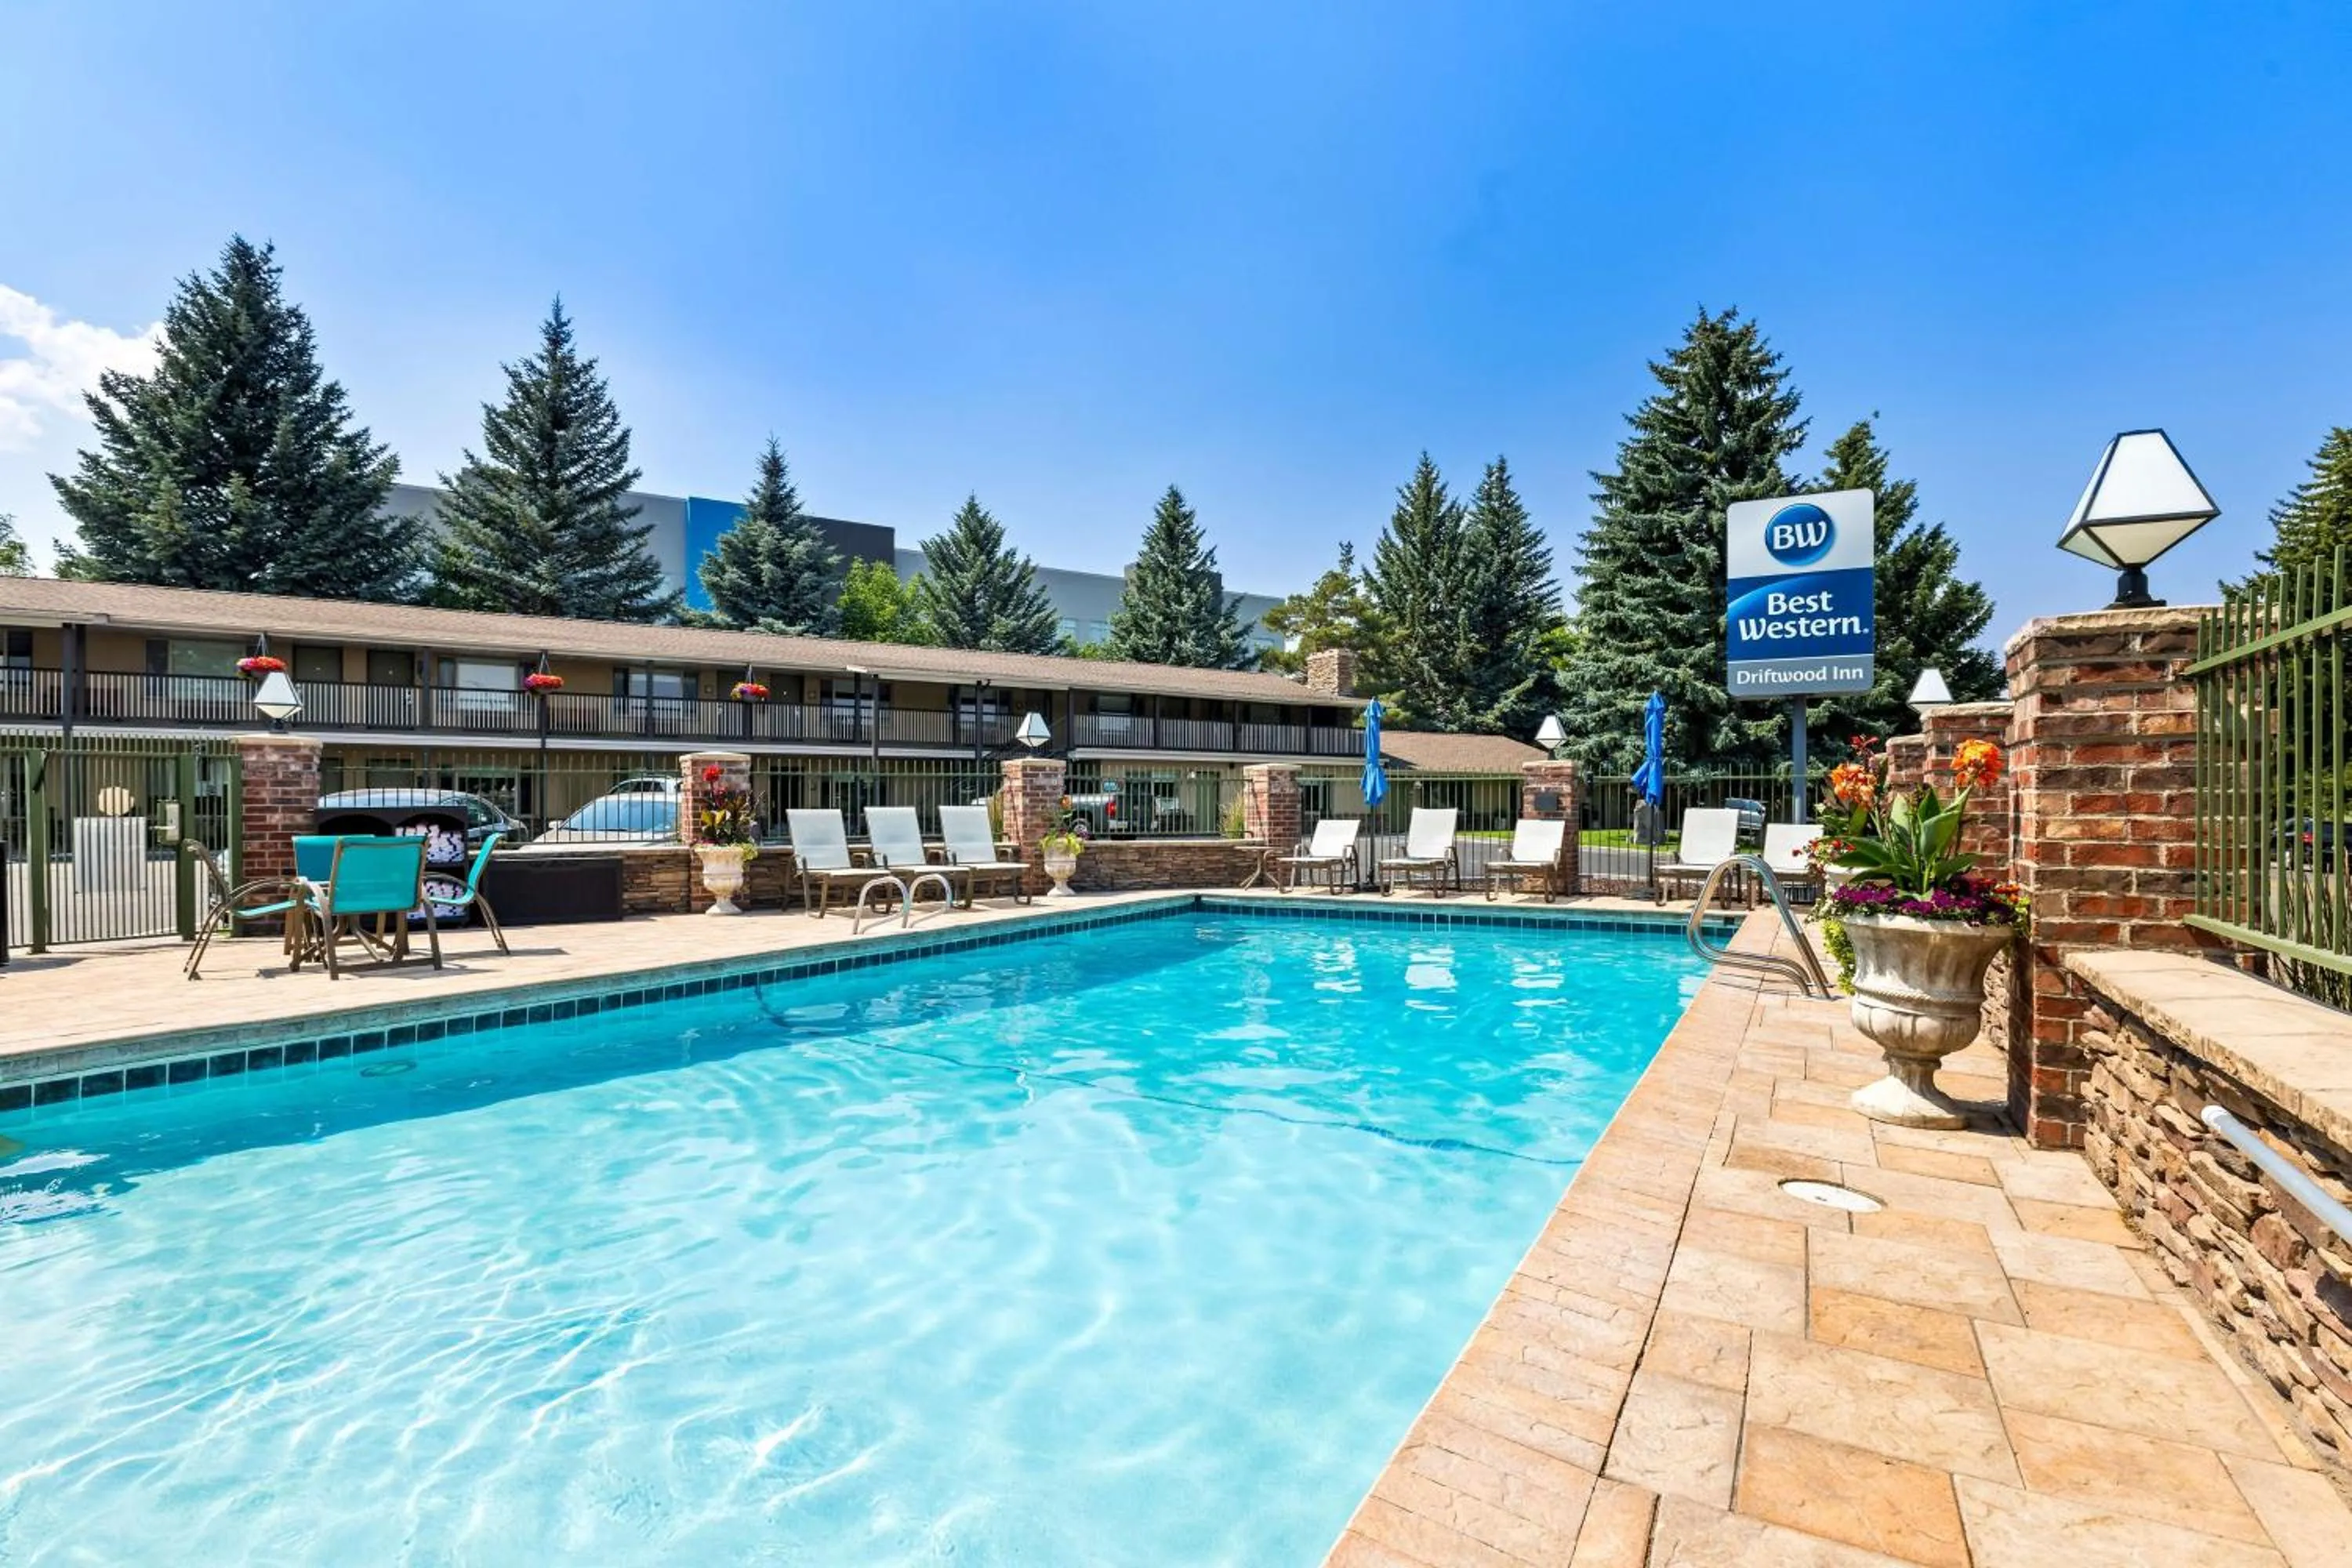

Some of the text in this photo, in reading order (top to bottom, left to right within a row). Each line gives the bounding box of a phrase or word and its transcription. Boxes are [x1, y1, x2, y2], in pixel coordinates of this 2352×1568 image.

[1773, 521, 1827, 550] BW
[1767, 590, 1833, 615] Best
[1736, 666, 1864, 684] Driftwood Inn
